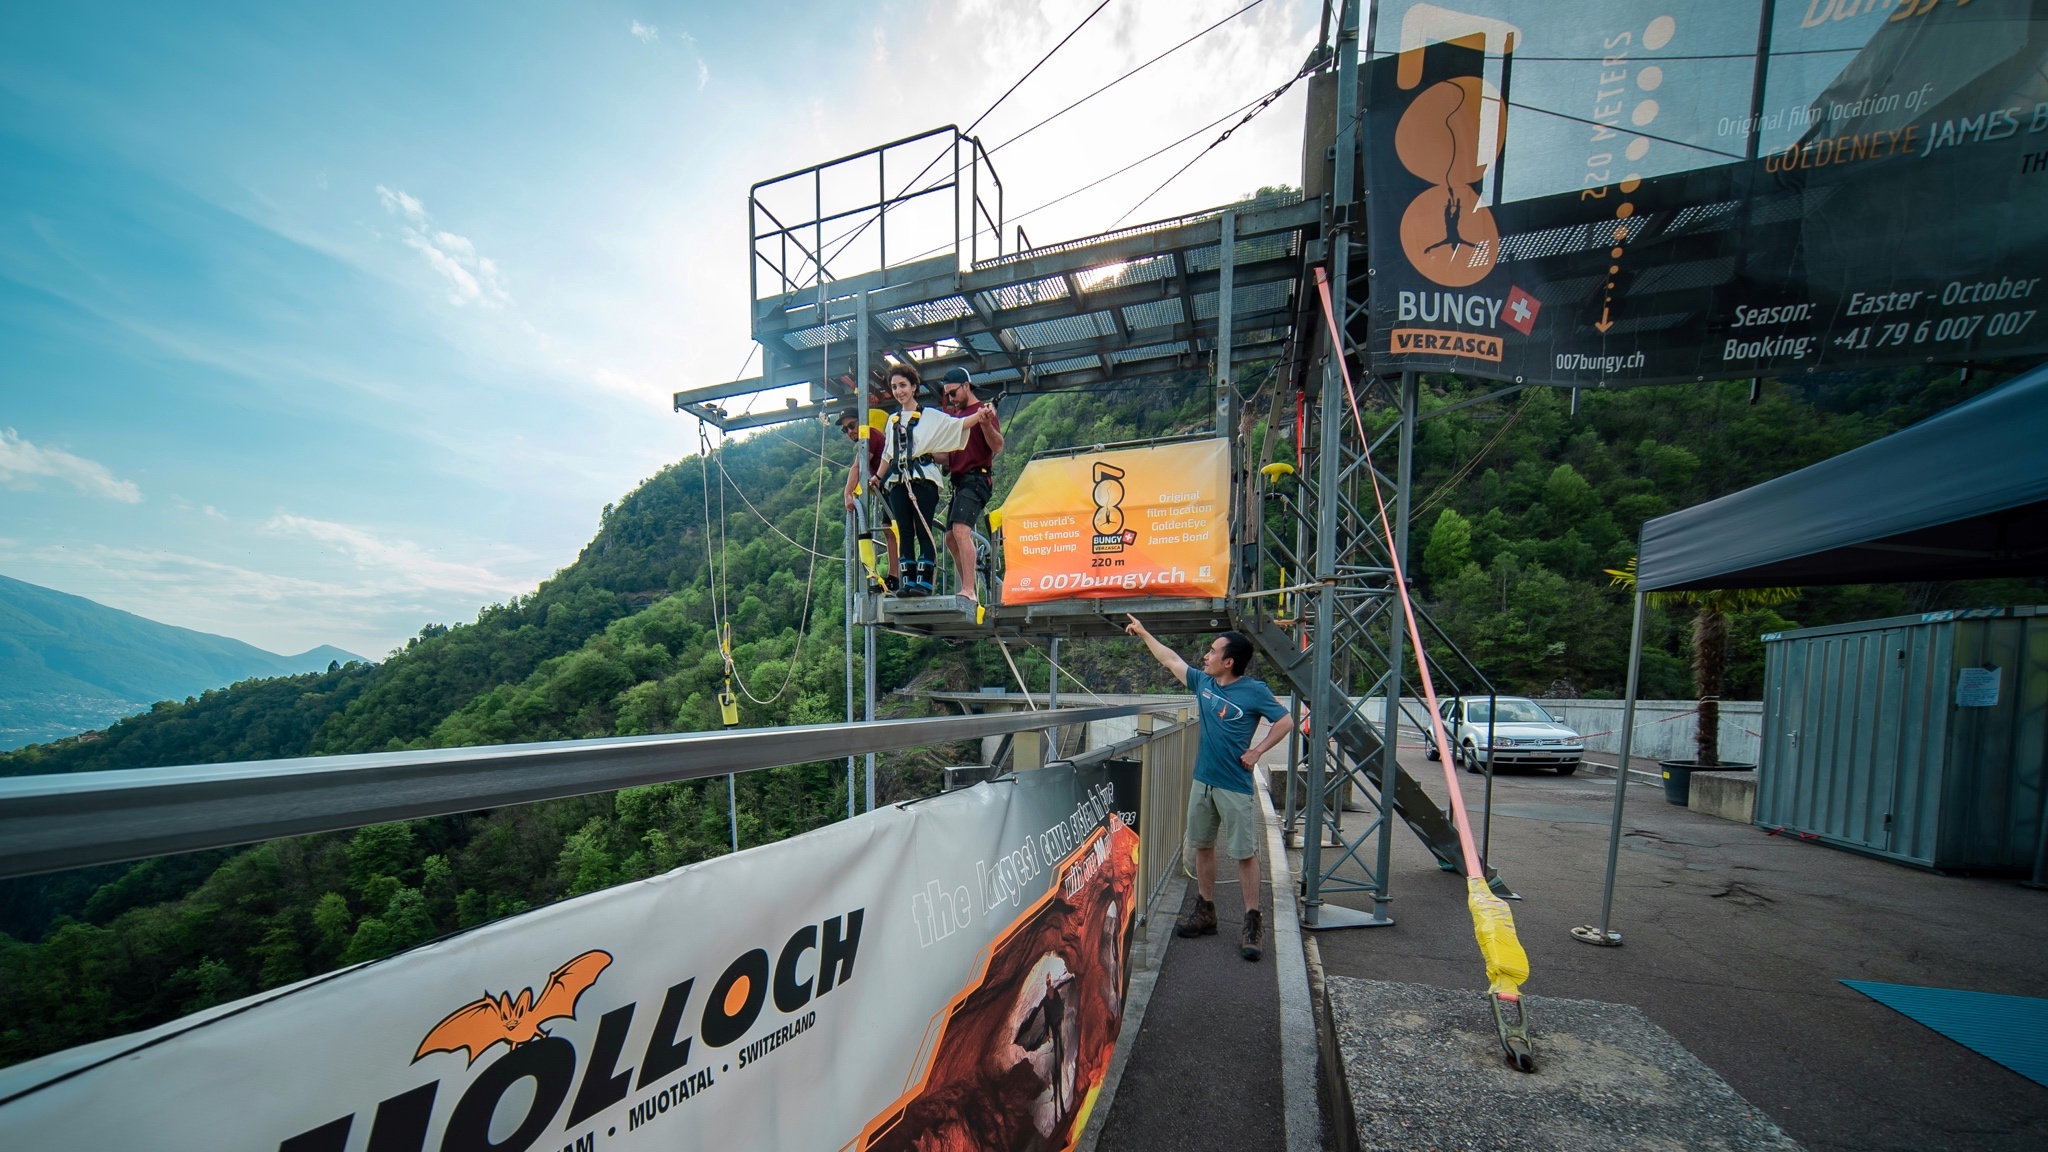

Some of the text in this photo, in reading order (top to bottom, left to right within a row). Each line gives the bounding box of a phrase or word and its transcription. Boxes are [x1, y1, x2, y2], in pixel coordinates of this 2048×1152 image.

[1581, 32, 1632, 201] 220 METERS
[1717, 82, 1934, 138] Original film location of:
[1765, 125, 1919, 174] GOLDENEYE
[1920, 106, 2021, 158] JAMES
[1398, 291, 1503, 329] BUNGY
[1730, 302, 1817, 328] Season:
[1846, 290, 1923, 316] Easter
[1942, 276, 2041, 306] October
[1396, 333, 1499, 357] VERZASCA
[1723, 310, 2038, 361] Booking: +41 79 6 007 007
[1556, 351, 1645, 373] 007bungy.ch
[1159, 490, 1201, 504] Original
[1147, 503, 1212, 518] film location
[1022, 516, 1075, 529] the world's
[1151, 518, 1207, 532] GoldenEye
[1019, 529, 1080, 543] most famous
[1093, 536, 1122, 544] BUNGY
[1148, 531, 1209, 546] James Bond
[1022, 544, 1077, 557] Bungy Jump
[1091, 558, 1112, 567] 220
[1039, 566, 1186, 590] 007bungy.ch
[912, 879, 971, 949] the
[976, 834, 1041, 917] largest
[1040, 820, 1072, 866] cave
[629, 1010, 816, 1133] MUOTATAL SWITZERLAND
